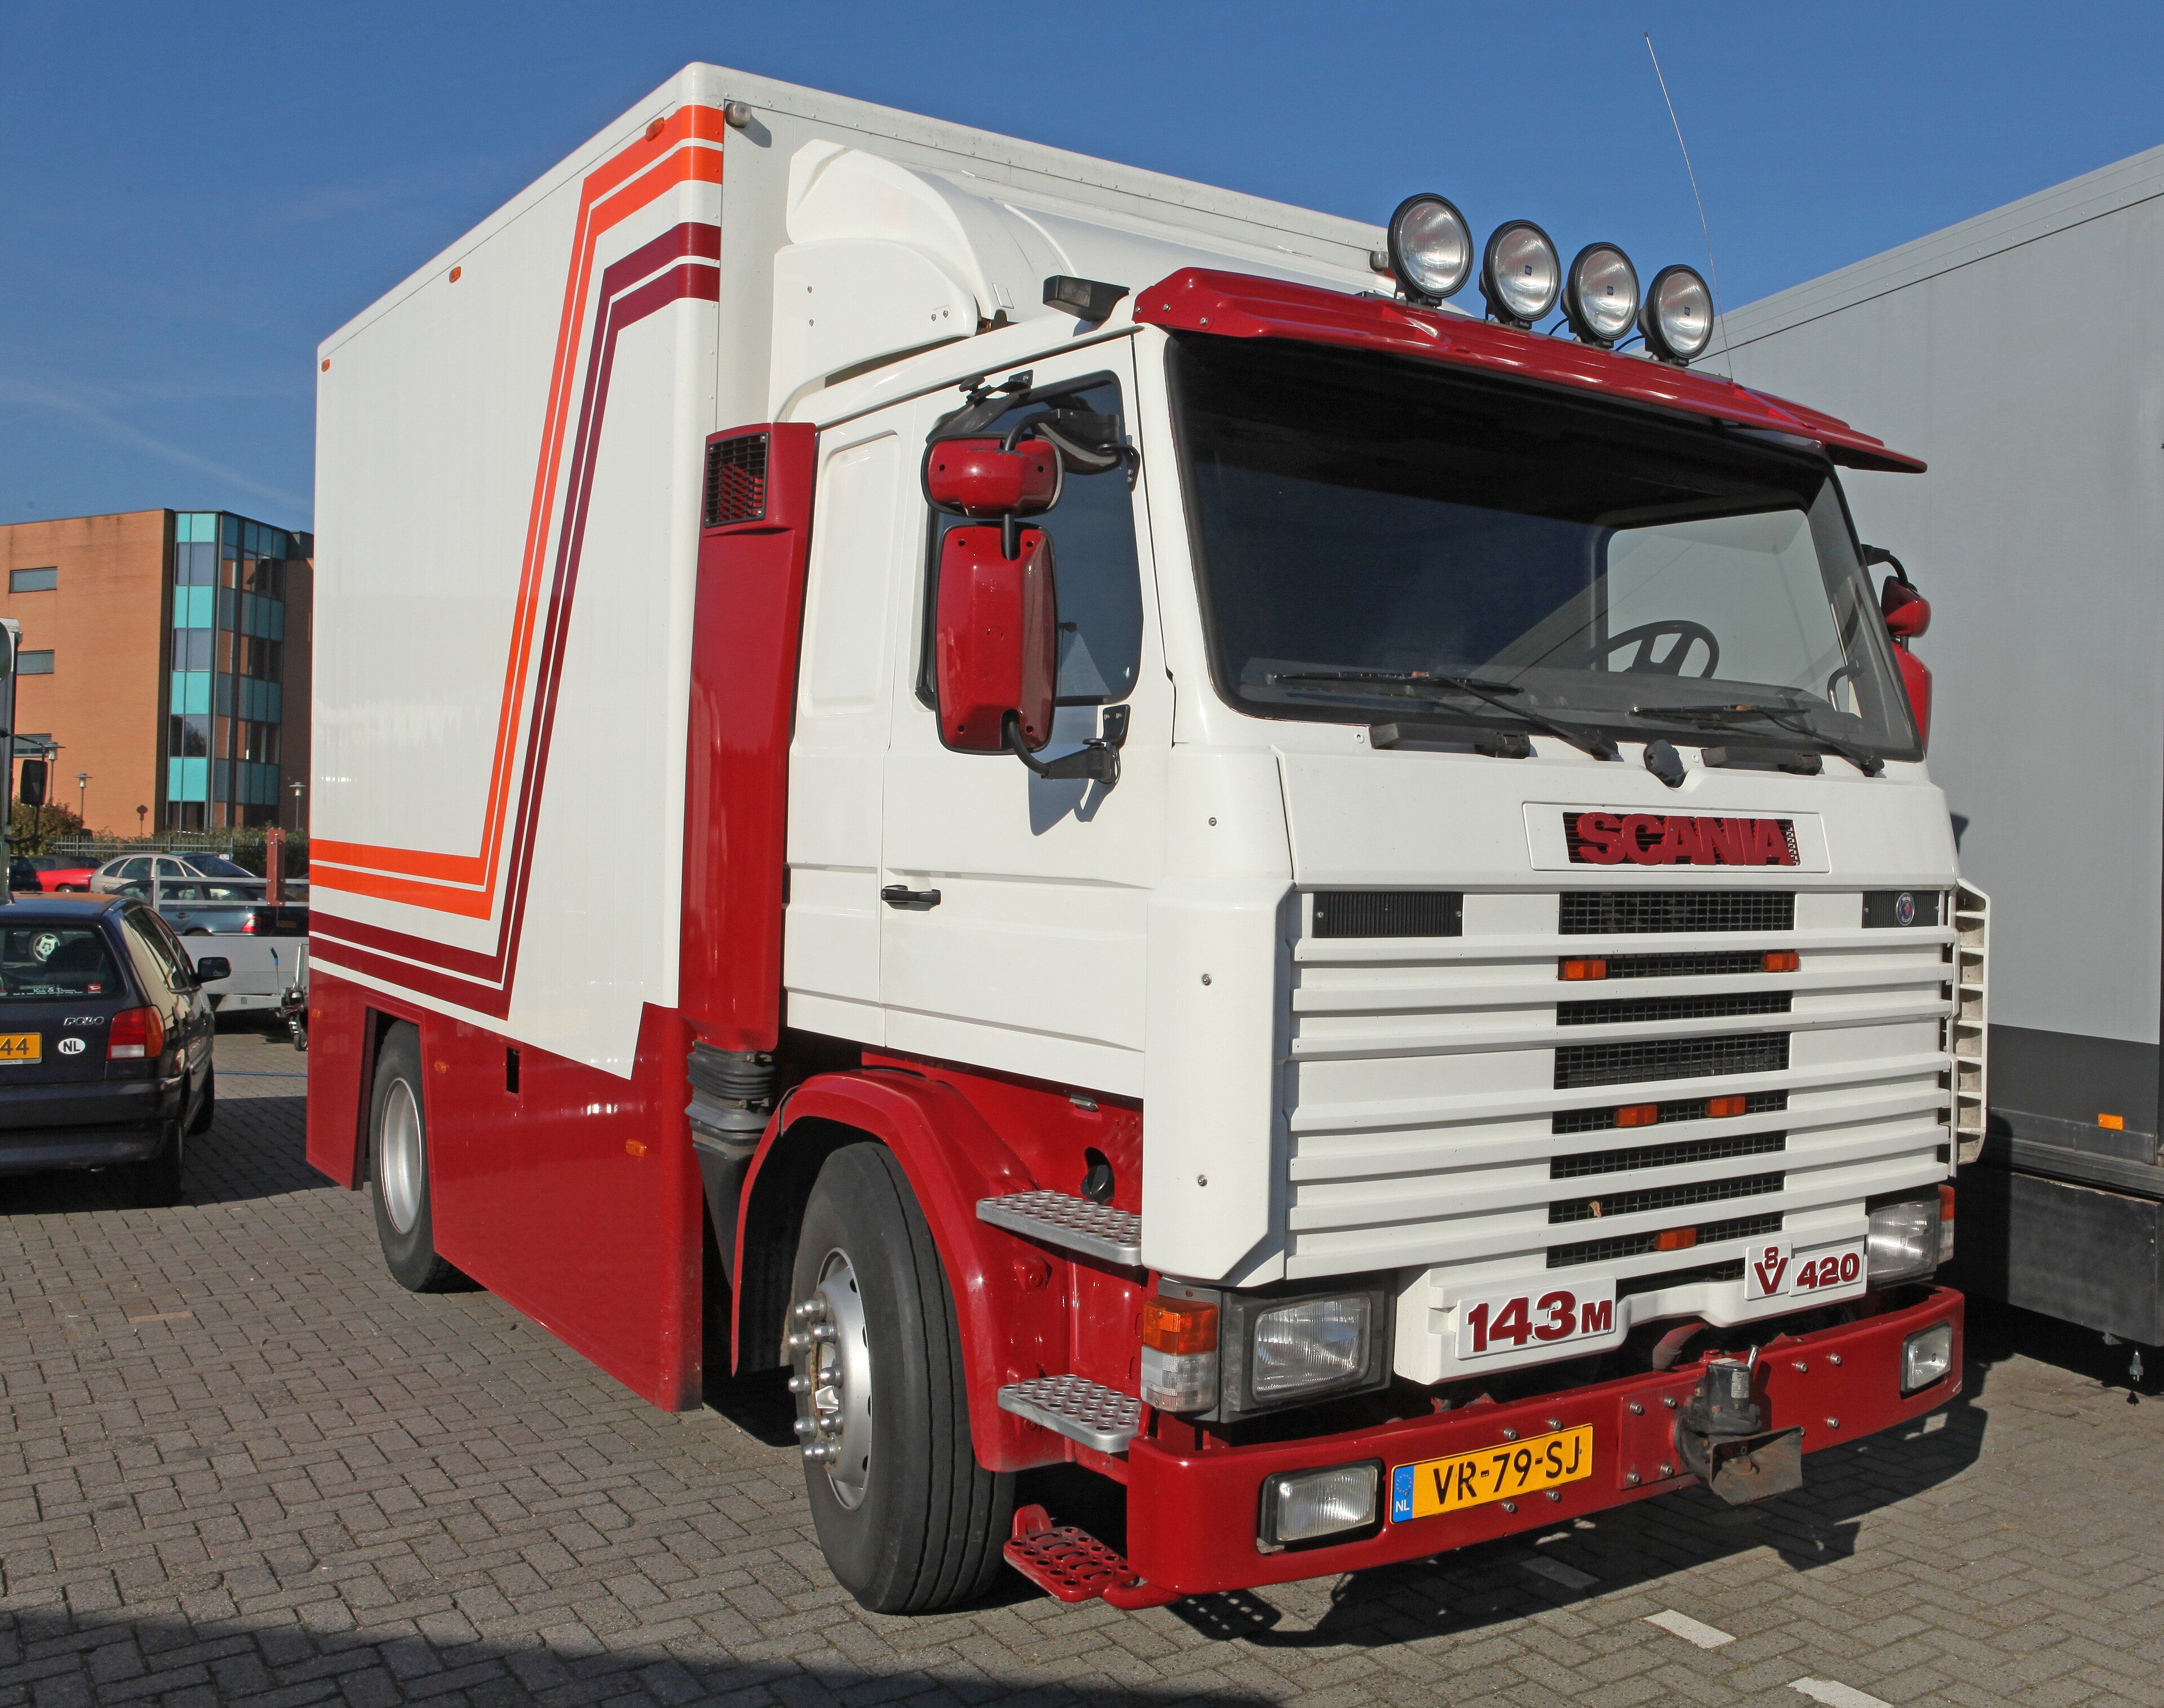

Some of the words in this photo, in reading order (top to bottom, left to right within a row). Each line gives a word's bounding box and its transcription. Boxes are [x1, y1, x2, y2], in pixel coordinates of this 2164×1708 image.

[1577, 812, 1796, 866] SCANIA
[63, 1040, 81, 1052] NL
[1795, 1252, 1860, 1290] 420
[1395, 1499, 1410, 1513] NL
[1433, 1436, 1580, 1505] VR-79-SJ
